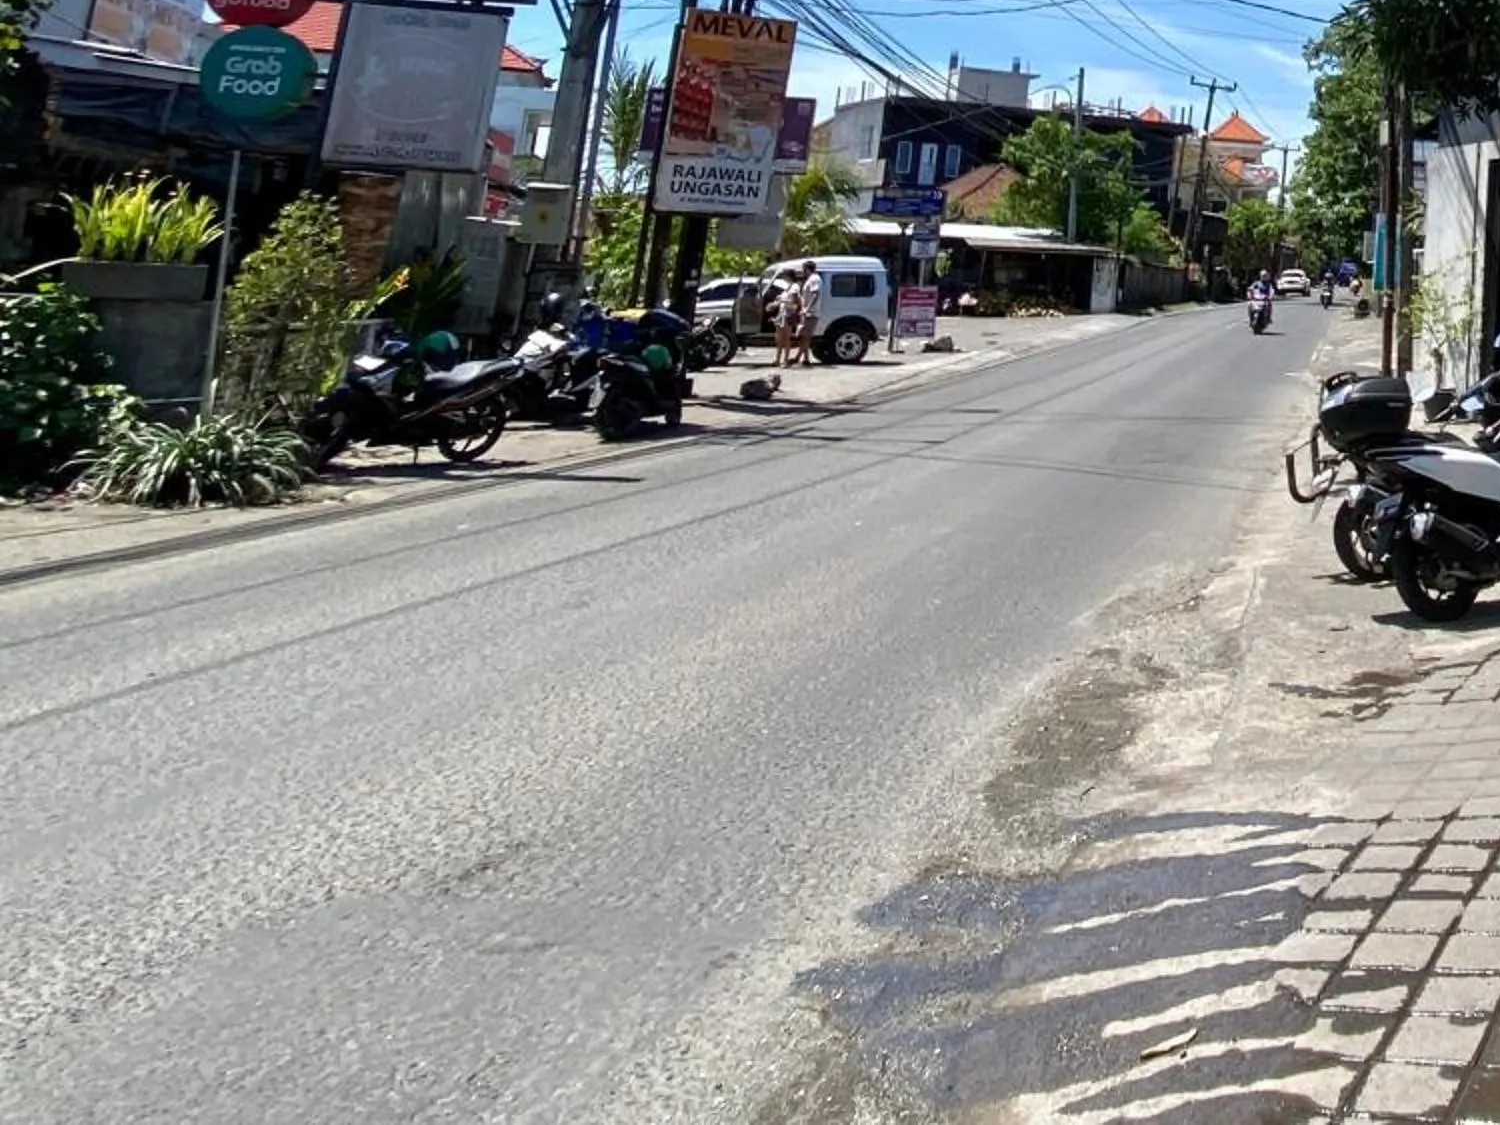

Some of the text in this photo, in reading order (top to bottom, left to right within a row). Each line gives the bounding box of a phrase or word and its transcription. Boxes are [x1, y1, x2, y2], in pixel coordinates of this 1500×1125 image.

[692, 13, 789, 44] MEVAL
[225, 55, 283, 76] Grab
[218, 75, 282, 96] Food
[673, 163, 763, 184] RAJAWALI
[670, 180, 760, 199] UNGASAN
